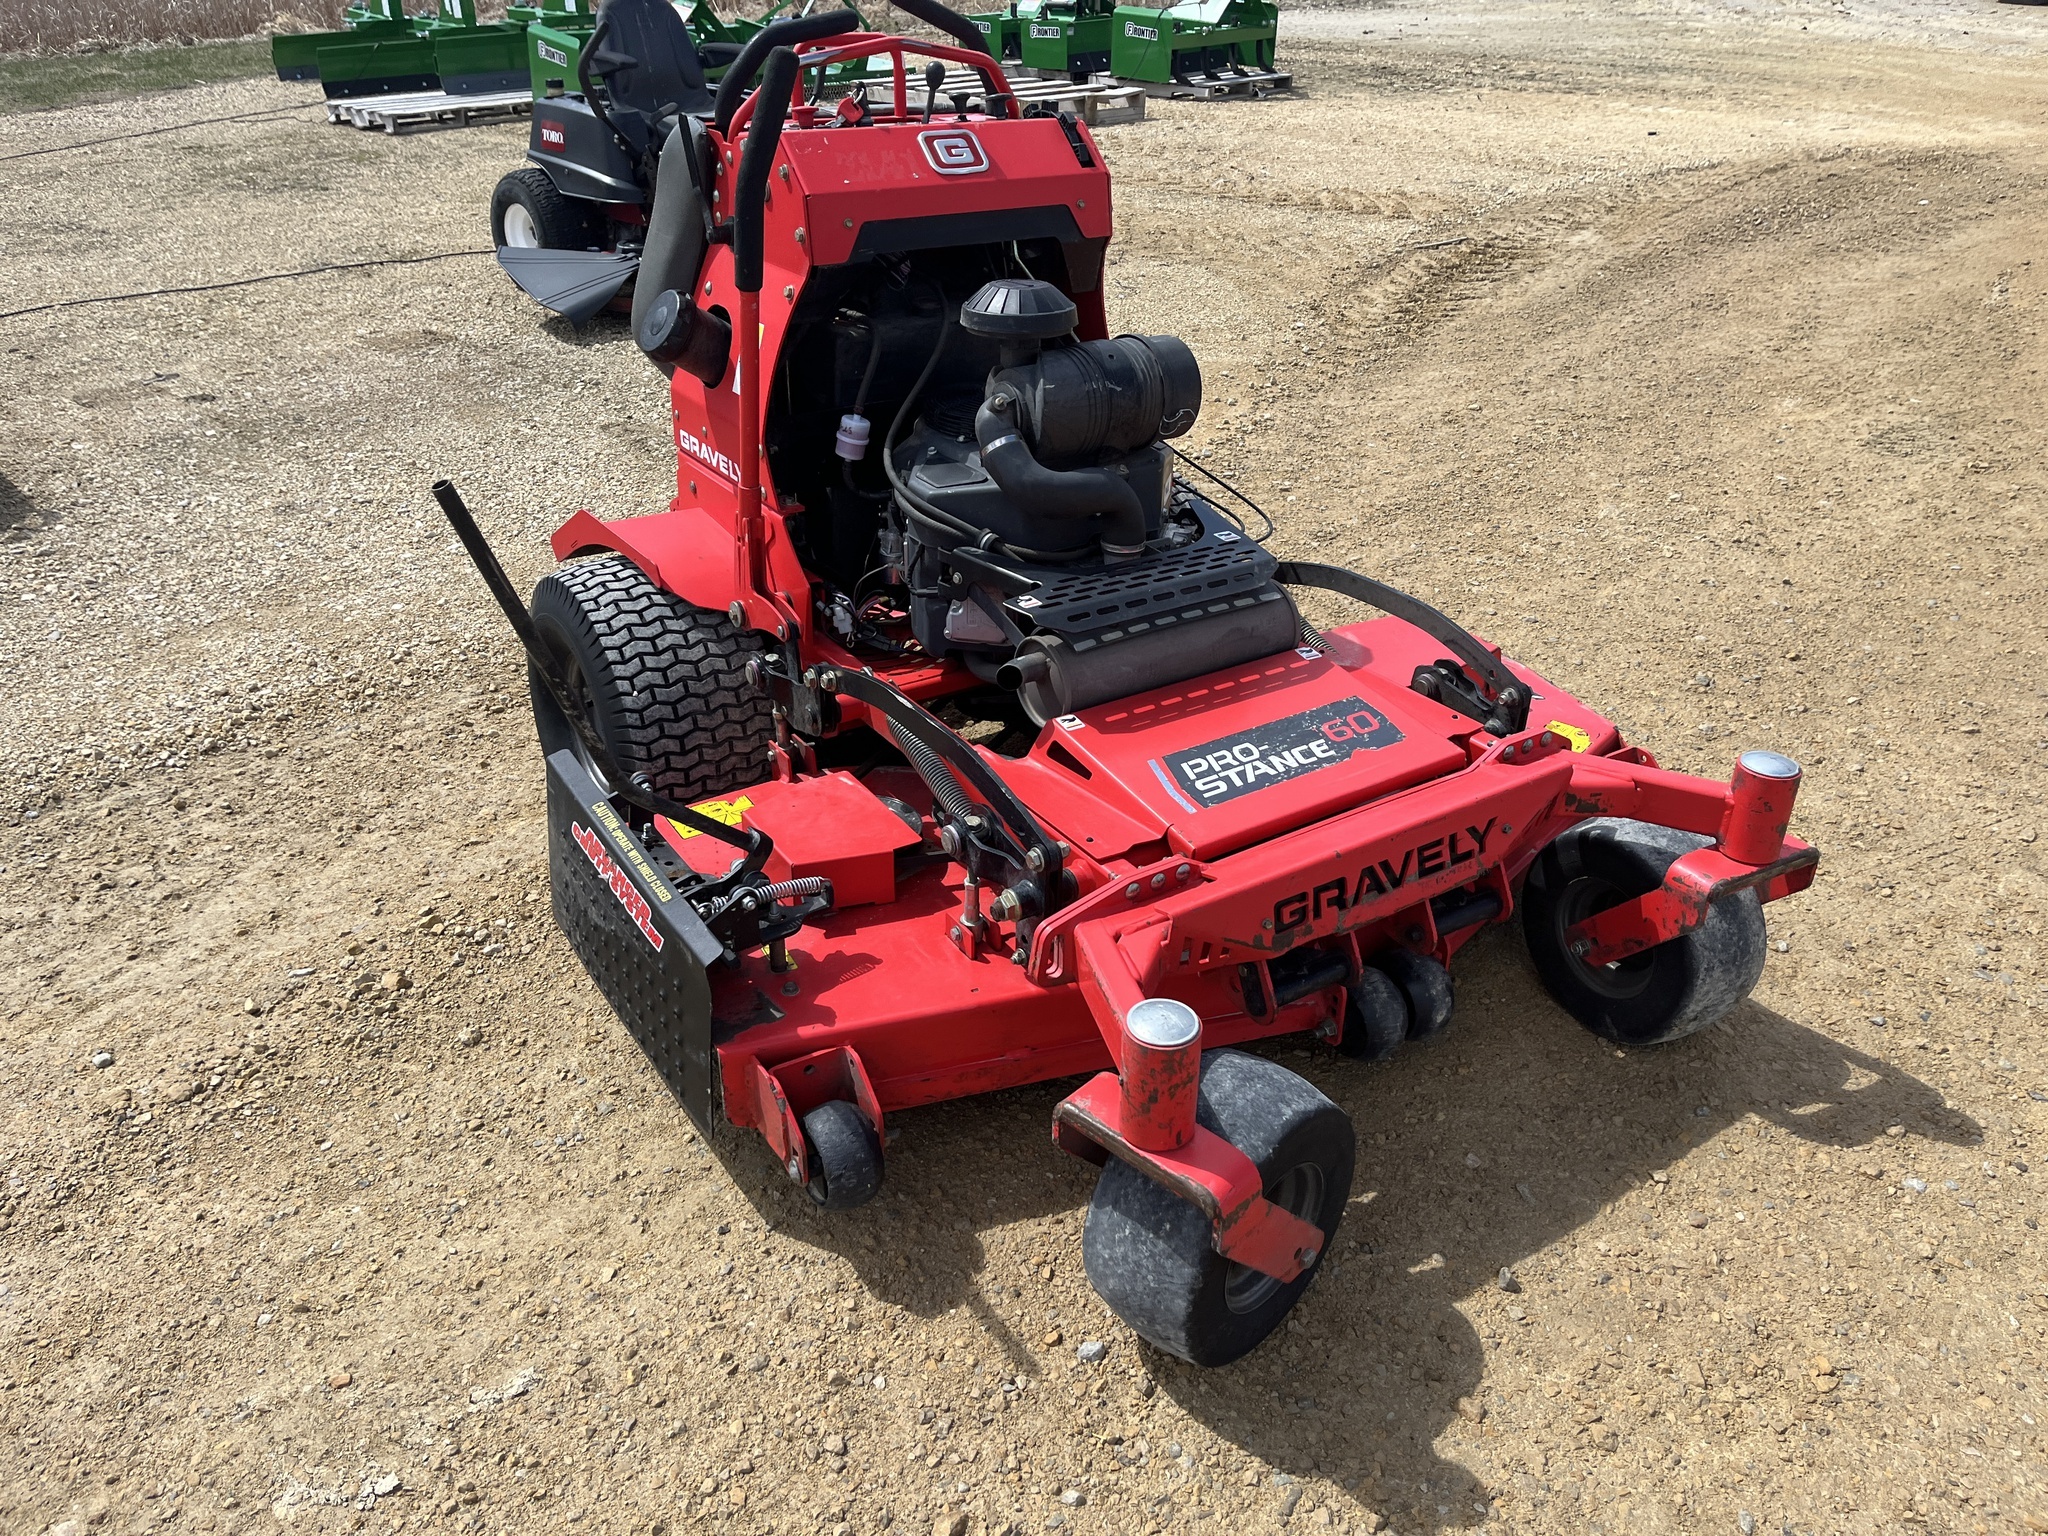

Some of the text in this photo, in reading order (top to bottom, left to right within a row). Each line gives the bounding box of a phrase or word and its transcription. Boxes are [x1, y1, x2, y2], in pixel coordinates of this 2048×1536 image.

[1031, 25, 1060, 37] FRONTIER
[1125, 23, 1158, 39] FRONTIER
[1180, 742, 1268, 780] PRO-
[1194, 710, 1380, 798] STANCE 60
[592, 801, 672, 902] CAUTION: OPERATE WITH SHIELD CLOSED
[1273, 816, 1499, 935] GRAVELY
